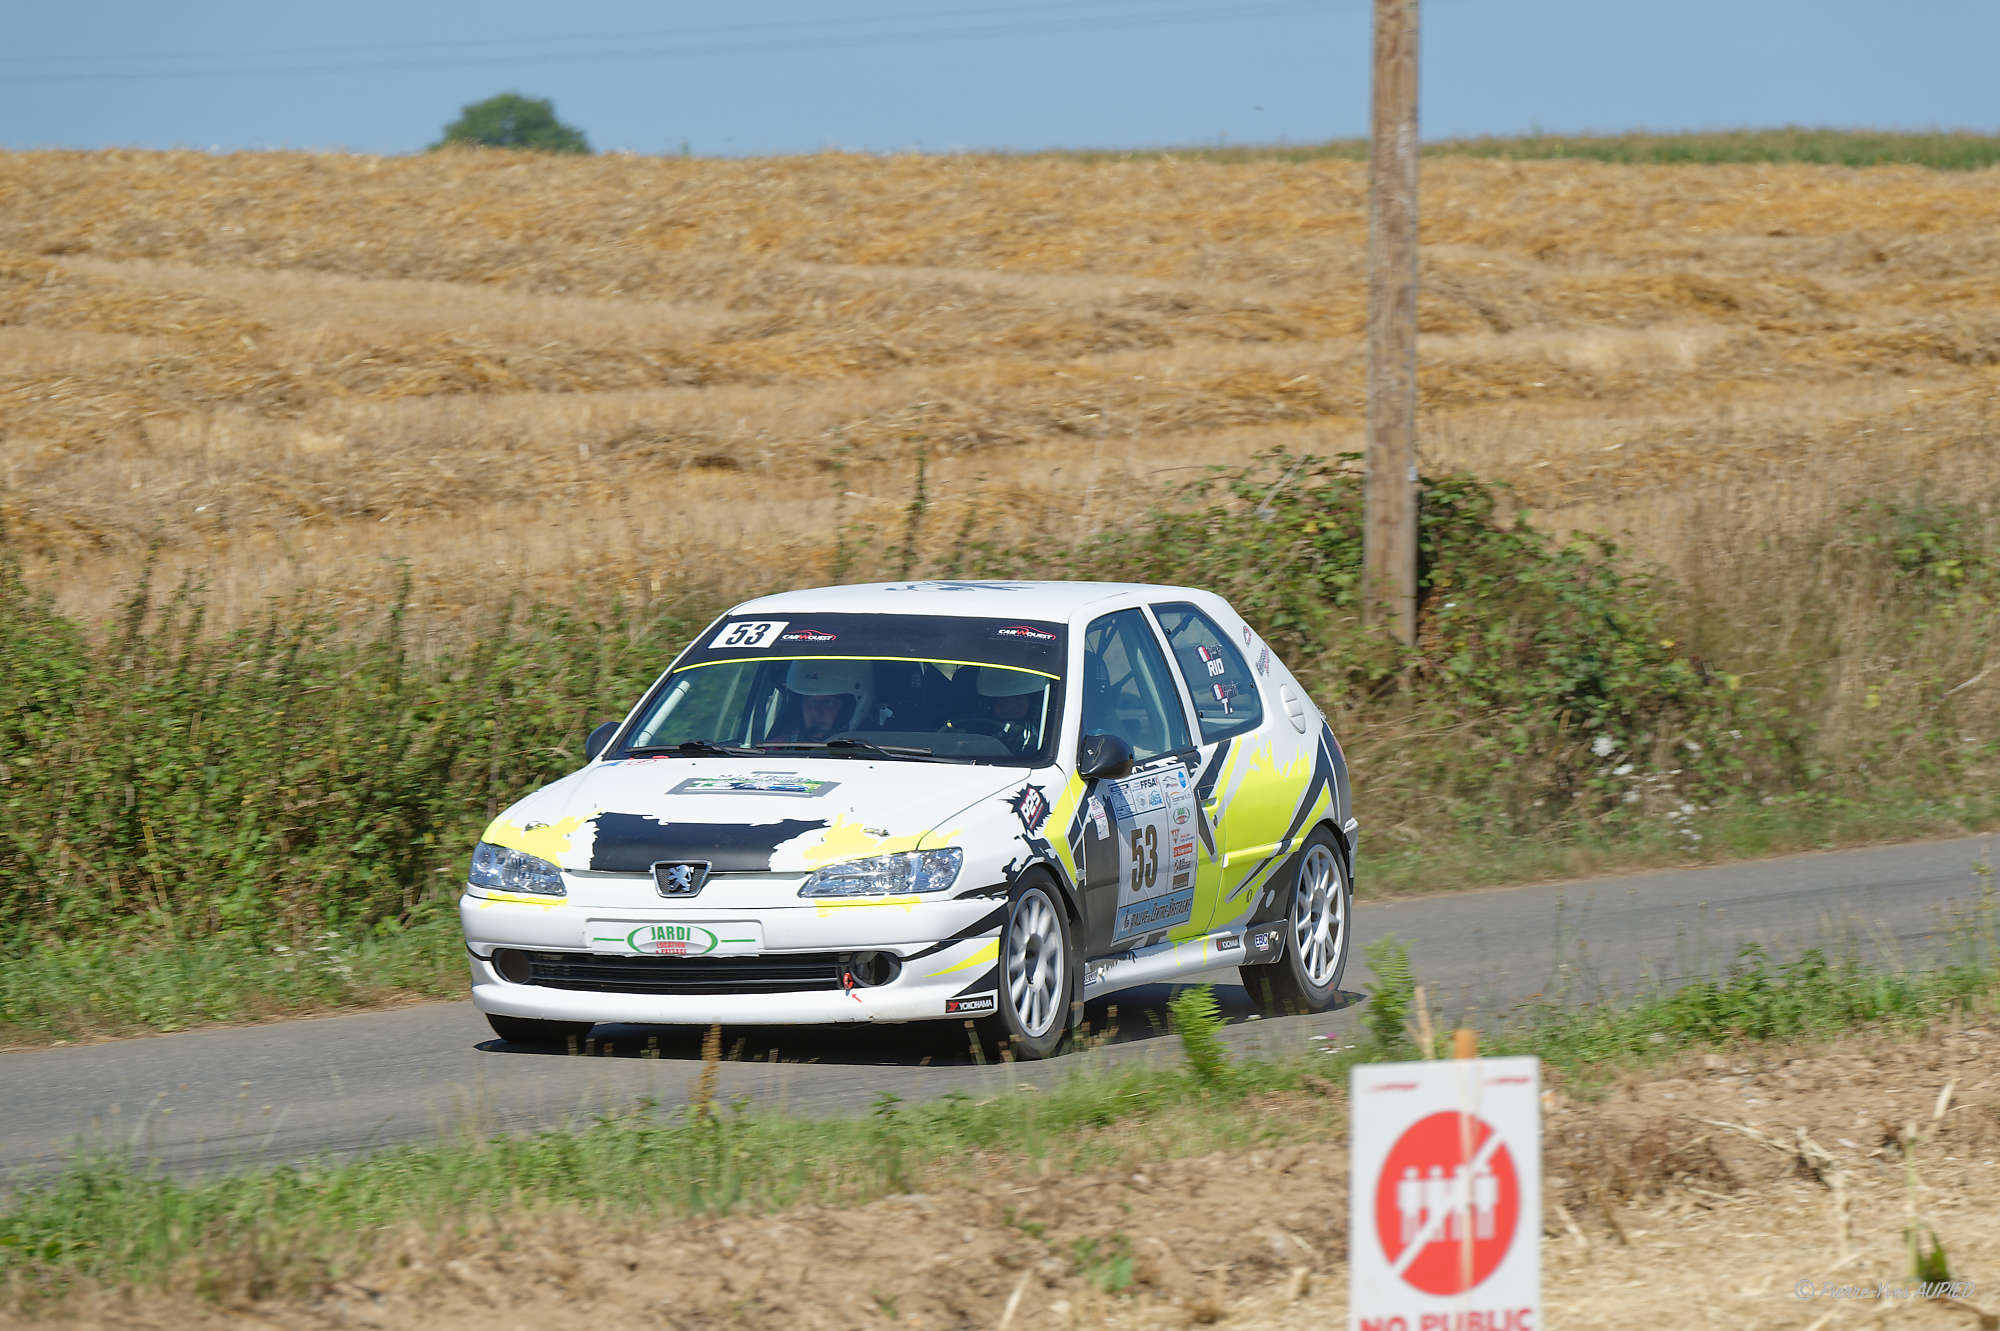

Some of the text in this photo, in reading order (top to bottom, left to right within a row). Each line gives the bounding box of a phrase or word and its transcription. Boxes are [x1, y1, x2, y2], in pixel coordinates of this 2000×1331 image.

[727, 623, 771, 645] 53
[1140, 777, 1157, 790] FFSA
[1131, 824, 1157, 892] 53
[650, 926, 691, 941] JARDI
[1255, 933, 1268, 946] EBC
[959, 999, 993, 1010] YOKOHAMA
[1420, 1308, 1533, 1331] PUBLIC
